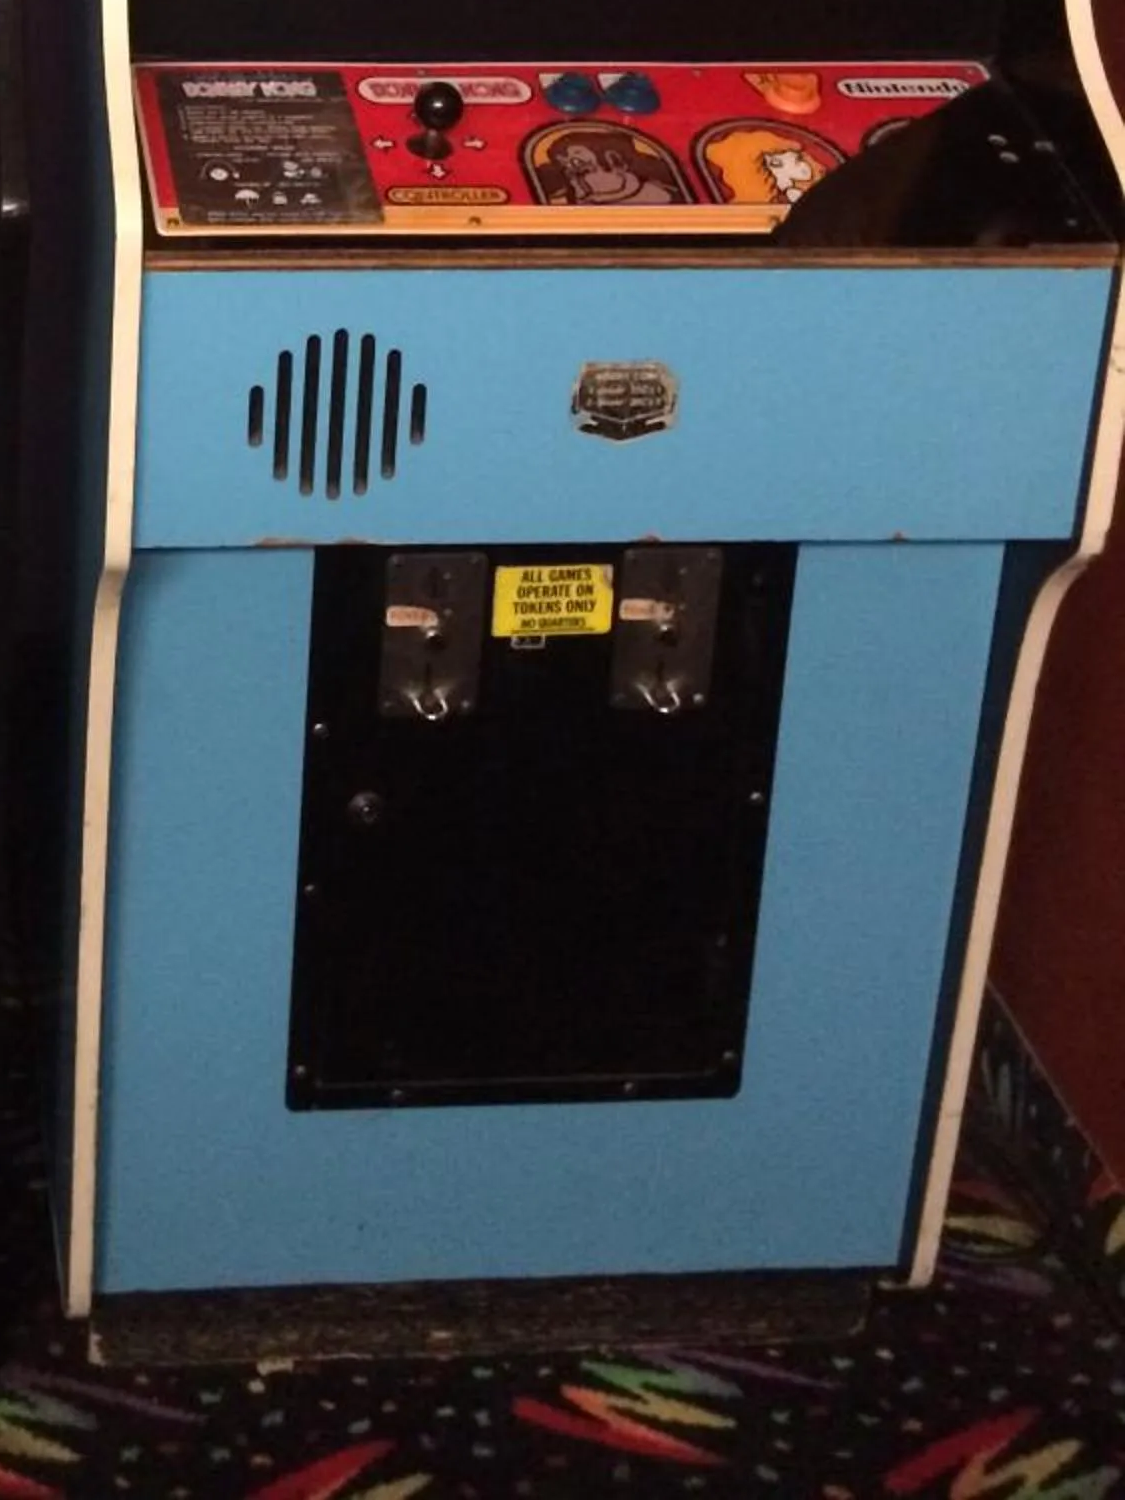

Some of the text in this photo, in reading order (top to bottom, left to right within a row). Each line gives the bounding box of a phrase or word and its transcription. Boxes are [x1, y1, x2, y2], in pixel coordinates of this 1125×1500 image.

[521, 567, 592, 582] ALL GAMES
[516, 583, 595, 599] OPERATE ON
[513, 598, 597, 615] TOKENS ONLY
